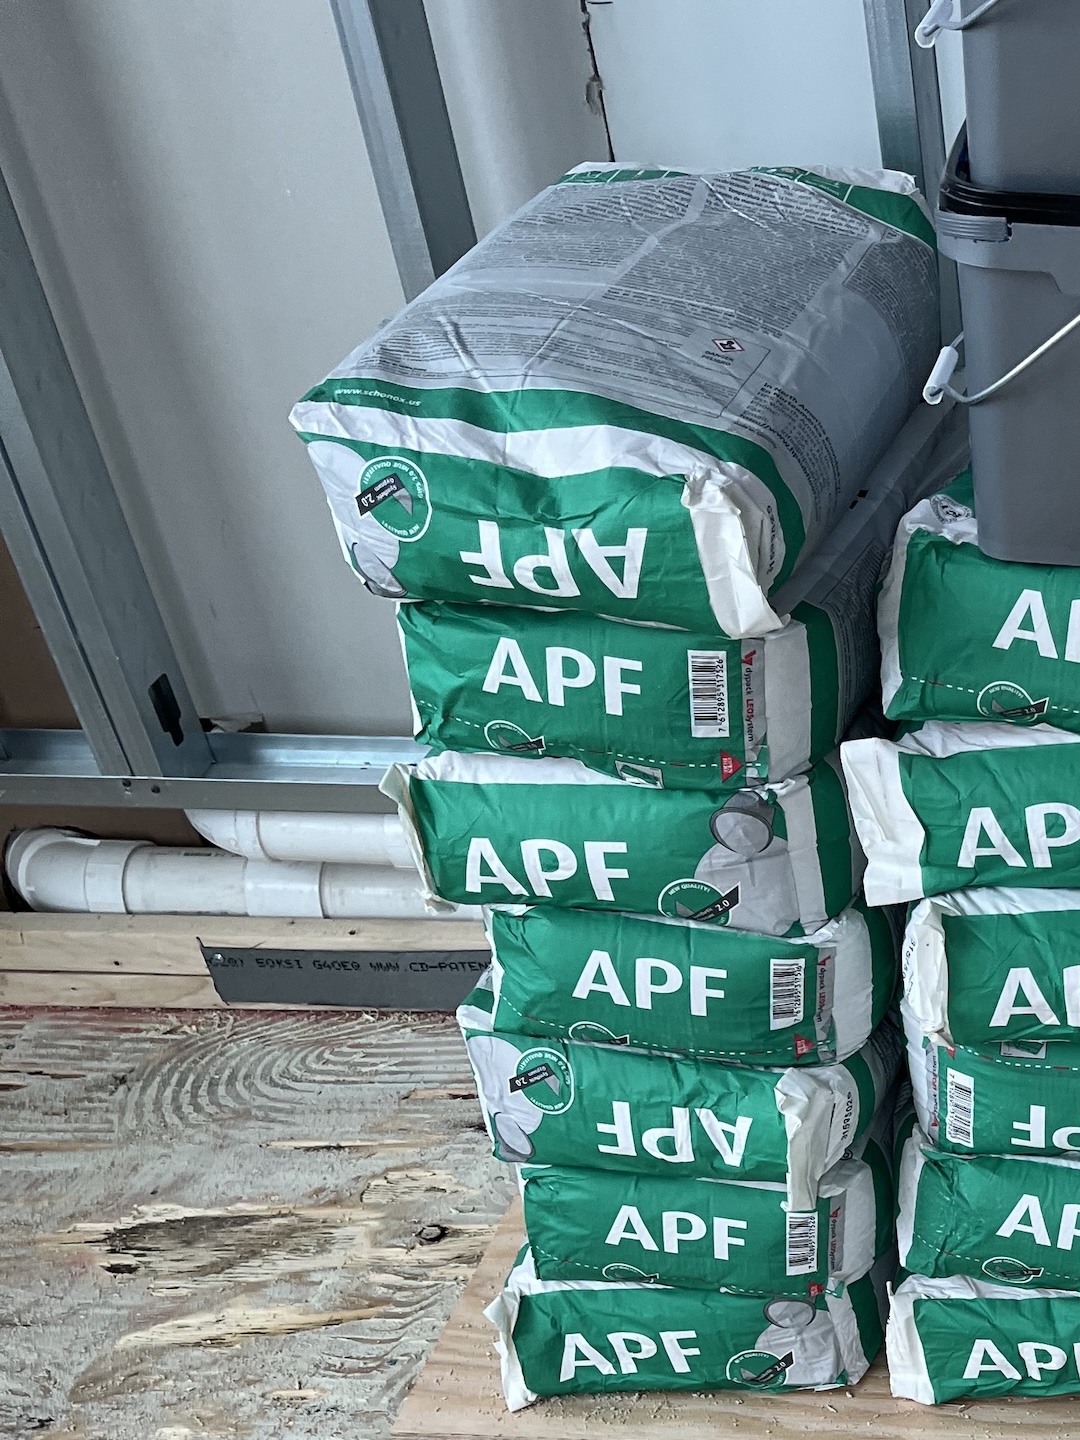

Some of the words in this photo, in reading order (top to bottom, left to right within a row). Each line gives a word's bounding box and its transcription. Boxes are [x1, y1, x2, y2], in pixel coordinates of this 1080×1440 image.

[335, 388, 422, 407] www.schonox.us
[361, 492, 376, 508] 2.0
[460, 520, 648, 598] APF
[482, 637, 642, 716] APF
[715, 658, 725, 688] 317526
[716, 692, 726, 723] 612895
[466, 838, 629, 901] APF
[667, 885, 681, 896] NEW
[680, 883, 711, 893] QUALITY!
[714, 899, 730, 912] 2.0
[572, 950, 727, 1016] APF
[514, 1076, 528, 1087] 2.0
[597, 1101, 752, 1167] APF
[605, 1205, 747, 1260] APF
[560, 1331, 700, 1382] APF
[773, 1361, 787, 1372] 2.0
